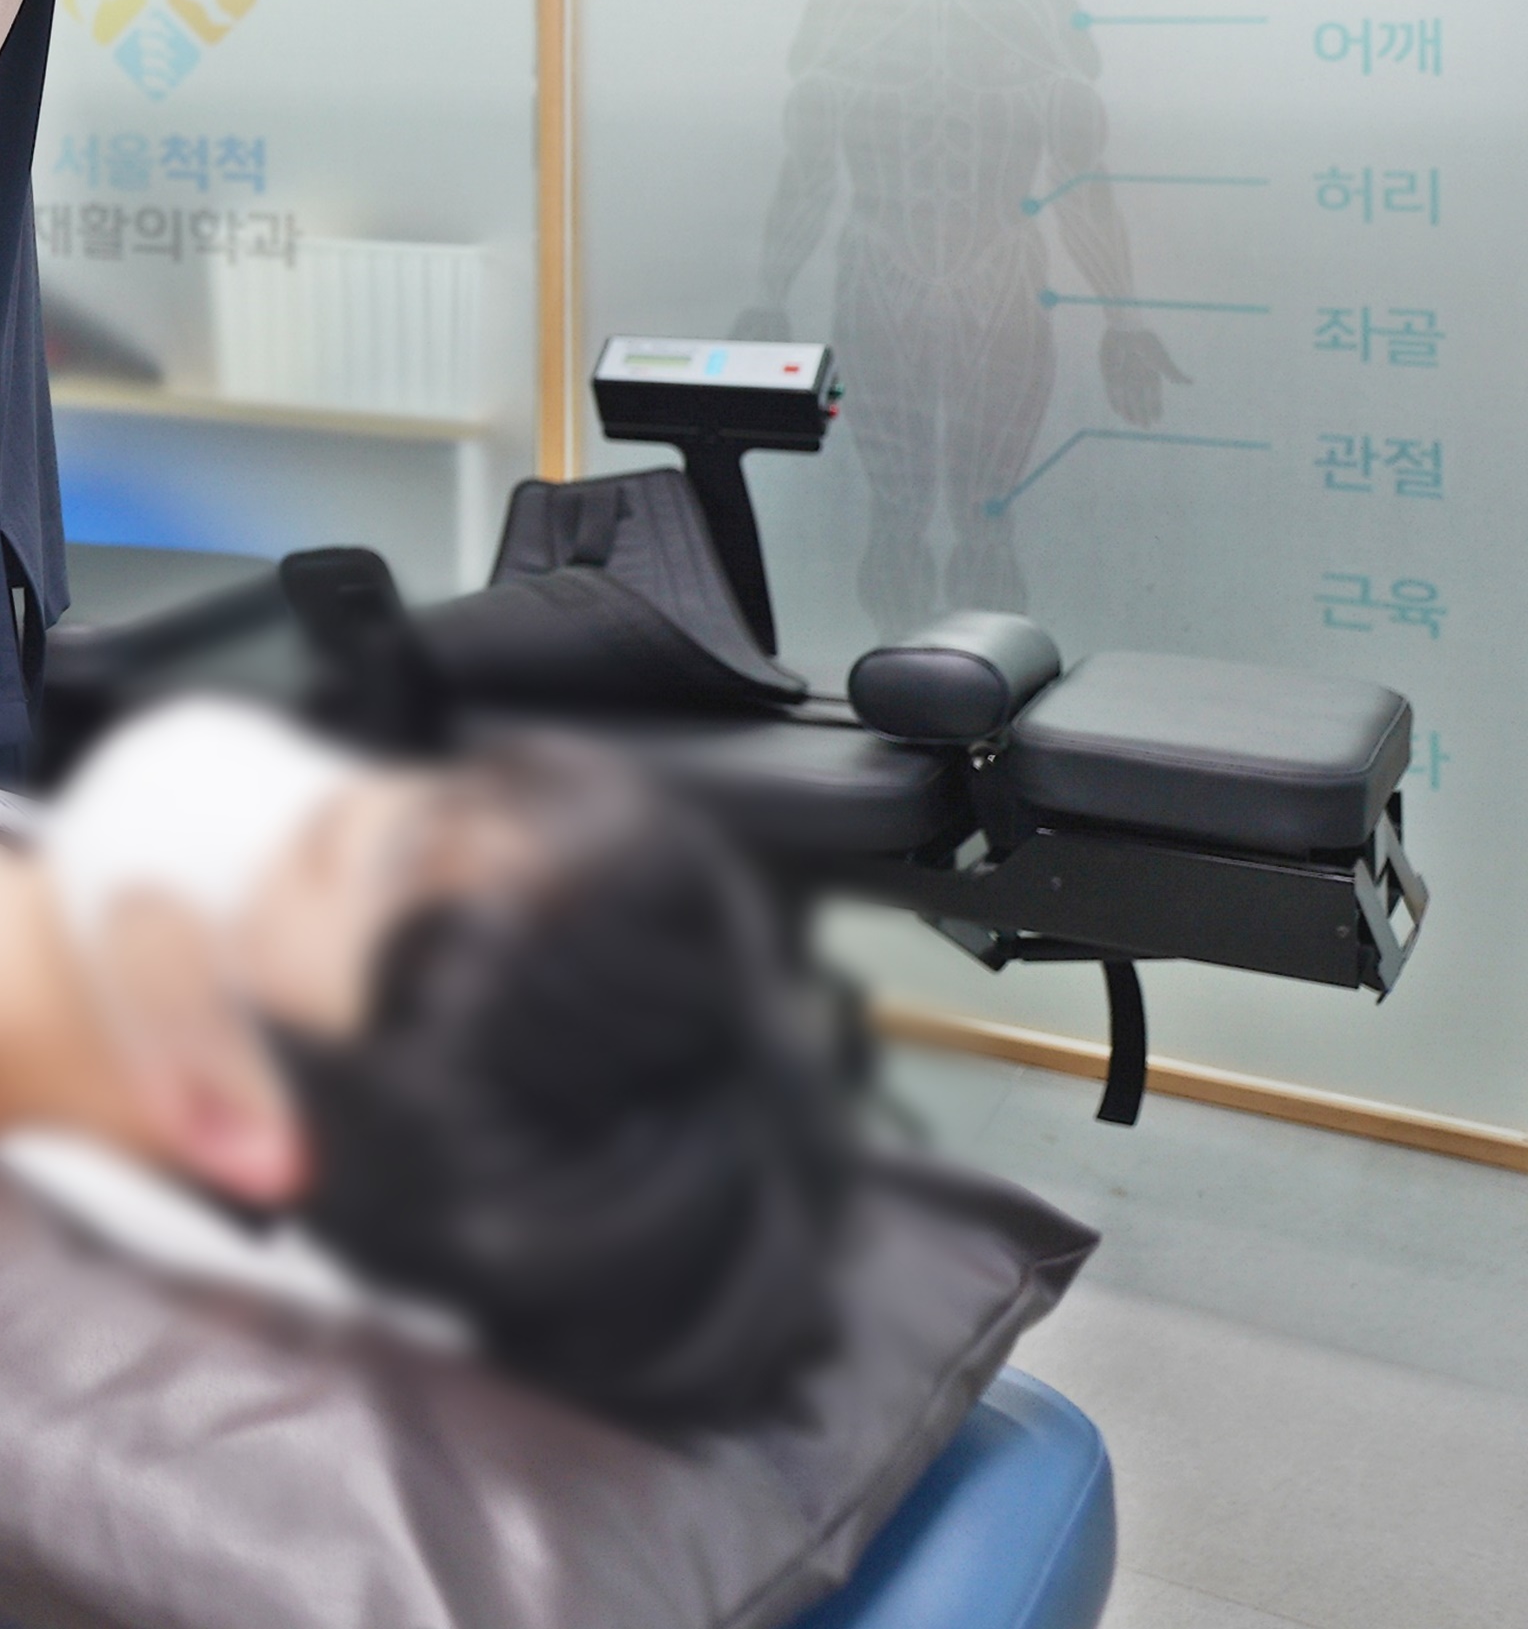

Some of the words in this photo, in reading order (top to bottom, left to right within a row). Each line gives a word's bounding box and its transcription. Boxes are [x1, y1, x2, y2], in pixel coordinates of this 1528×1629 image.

[1312, 17, 1442, 76] 어깨
[53, 132, 268, 193] 서울척척
[1312, 166, 1441, 228] 허리
[1312, 305, 1446, 368] 좌골
[1313, 432, 1445, 500] 관절
[1312, 572, 1448, 640] 근육
